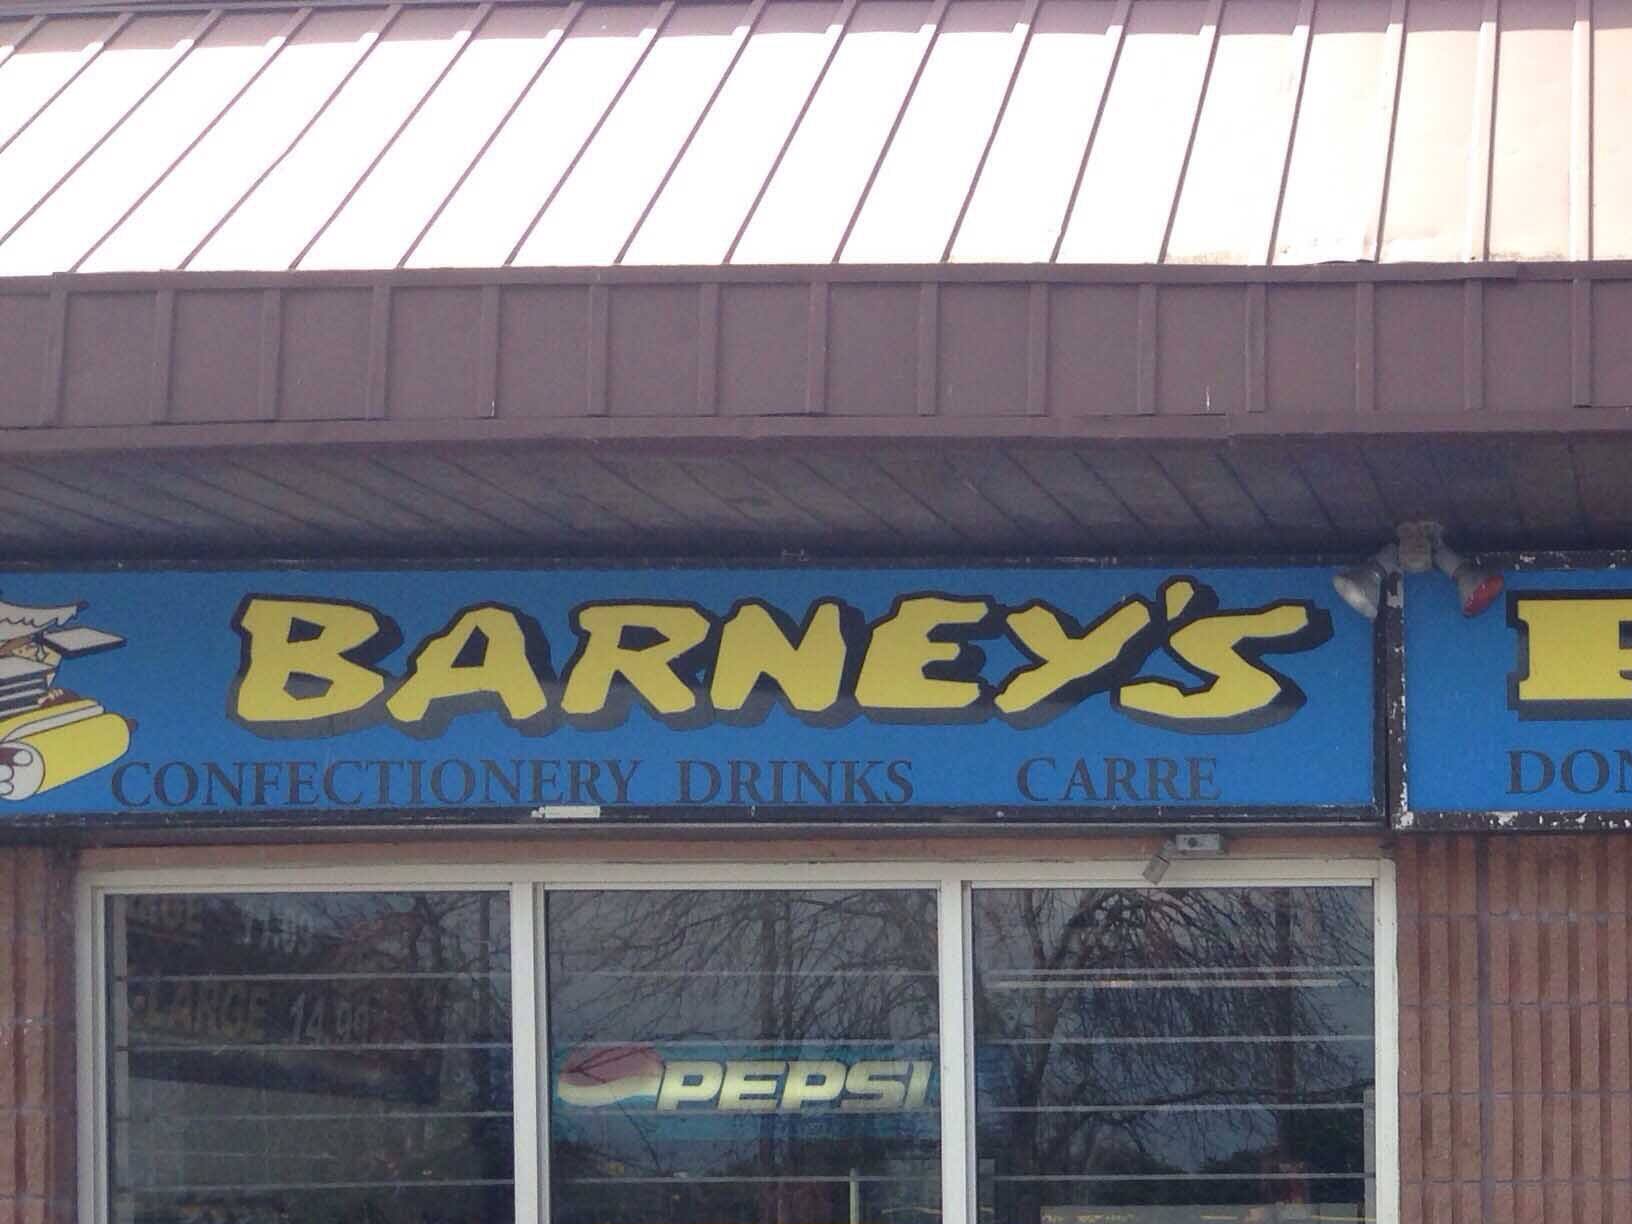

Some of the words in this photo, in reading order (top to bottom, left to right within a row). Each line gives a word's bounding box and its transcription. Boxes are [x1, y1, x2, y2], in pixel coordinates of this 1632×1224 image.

[228, 576, 1325, 734] BARNEY'S
[111, 758, 642, 806] CONFECTIONERY
[679, 758, 914, 804] DRINKS
[1016, 756, 1219, 802] CARRE
[656, 1059, 933, 1112] PEPSI
